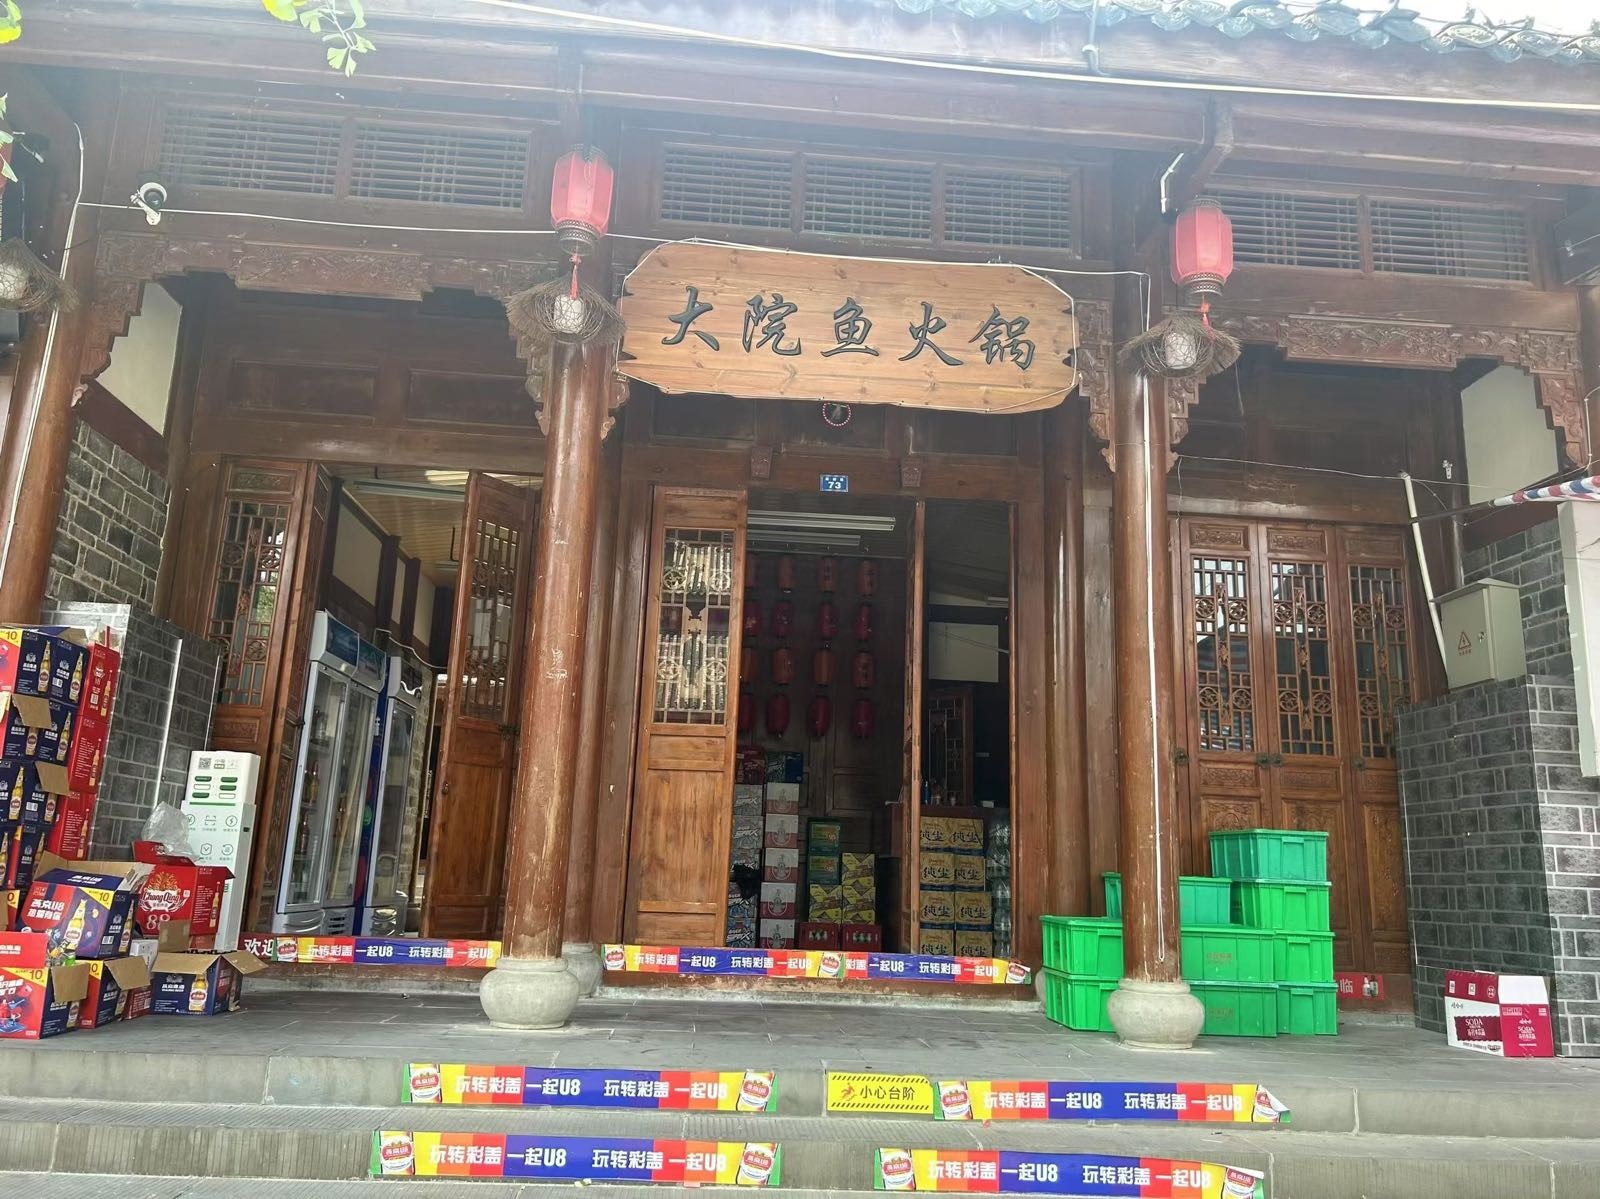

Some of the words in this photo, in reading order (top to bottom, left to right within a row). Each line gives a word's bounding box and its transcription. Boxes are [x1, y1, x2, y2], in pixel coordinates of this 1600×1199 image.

[661, 285, 1036, 371] 大院鱼火锅
[828, 481, 842, 489] 73
[244, 938, 275, 957] 欢迎
[409, 946, 454, 958] 玩转彩盖
[634, 953, 679, 966] 玩转彩盖
[680, 955, 716, 968] 一起U8
[731, 956, 774, 970] 玩转彩盖
[777, 958, 812, 970] 一起U8
[869, 959, 904, 972] 一起U8
[919, 962, 961, 975] 玩转彩盖
[963, 964, 999, 977] 一起U8
[29, 969, 43, 980] 10
[455, 1077, 522, 1095] 玩转彩盖
[526, 1079, 581, 1096] 一起U8
[604, 1080, 668, 1099] 玩转彩盖
[674, 1081, 728, 1100] 一起U8
[859, 1084, 916, 1101] 小心台阶
[984, 1092, 1046, 1109] 玩转彩盖
[1050, 1092, 1102, 1110] 一起U8
[1124, 1094, 1187, 1111] 玩转彩盖
[1191, 1095, 1243, 1112] 一起U8
[429, 1145, 502, 1164] 玩转彩盖
[507, 1147, 567, 1168] 一起U8
[591, 1149, 663, 1170] 玩转彩盖
[669, 1153, 727, 1172] 一起U8
[928, 1160, 997, 1179] 玩转彩盖
[1001, 1163, 1059, 1182] 一起U8
[1082, 1165, 1151, 1185] 玩转彩盖
[1155, 1168, 1213, 1188] 一起U8
